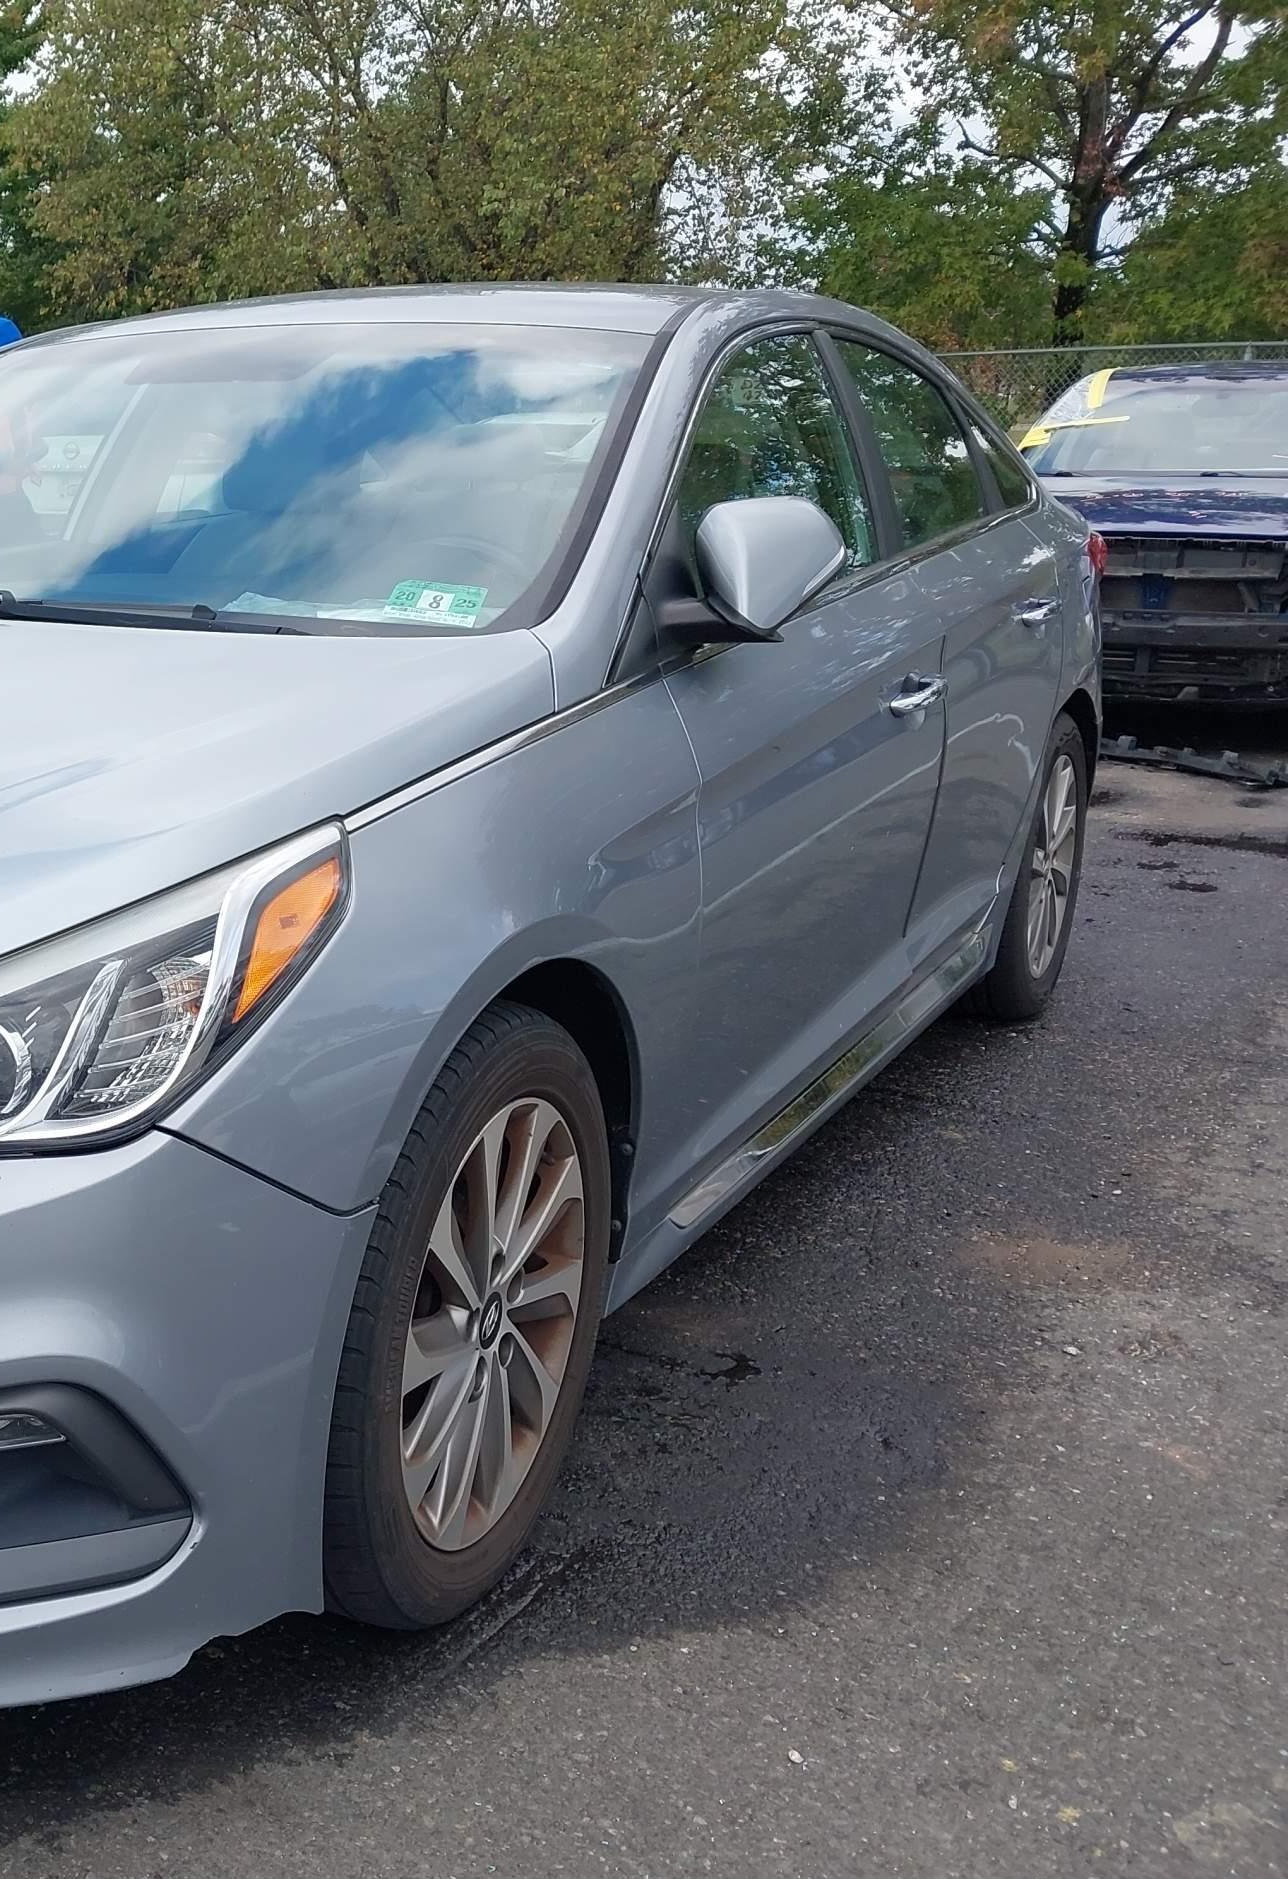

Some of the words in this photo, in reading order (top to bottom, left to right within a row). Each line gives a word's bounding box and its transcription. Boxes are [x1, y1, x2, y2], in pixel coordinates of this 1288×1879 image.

[395, 591, 416, 601] 20
[428, 594, 444, 609] 8
[455, 598, 477, 609] 25
